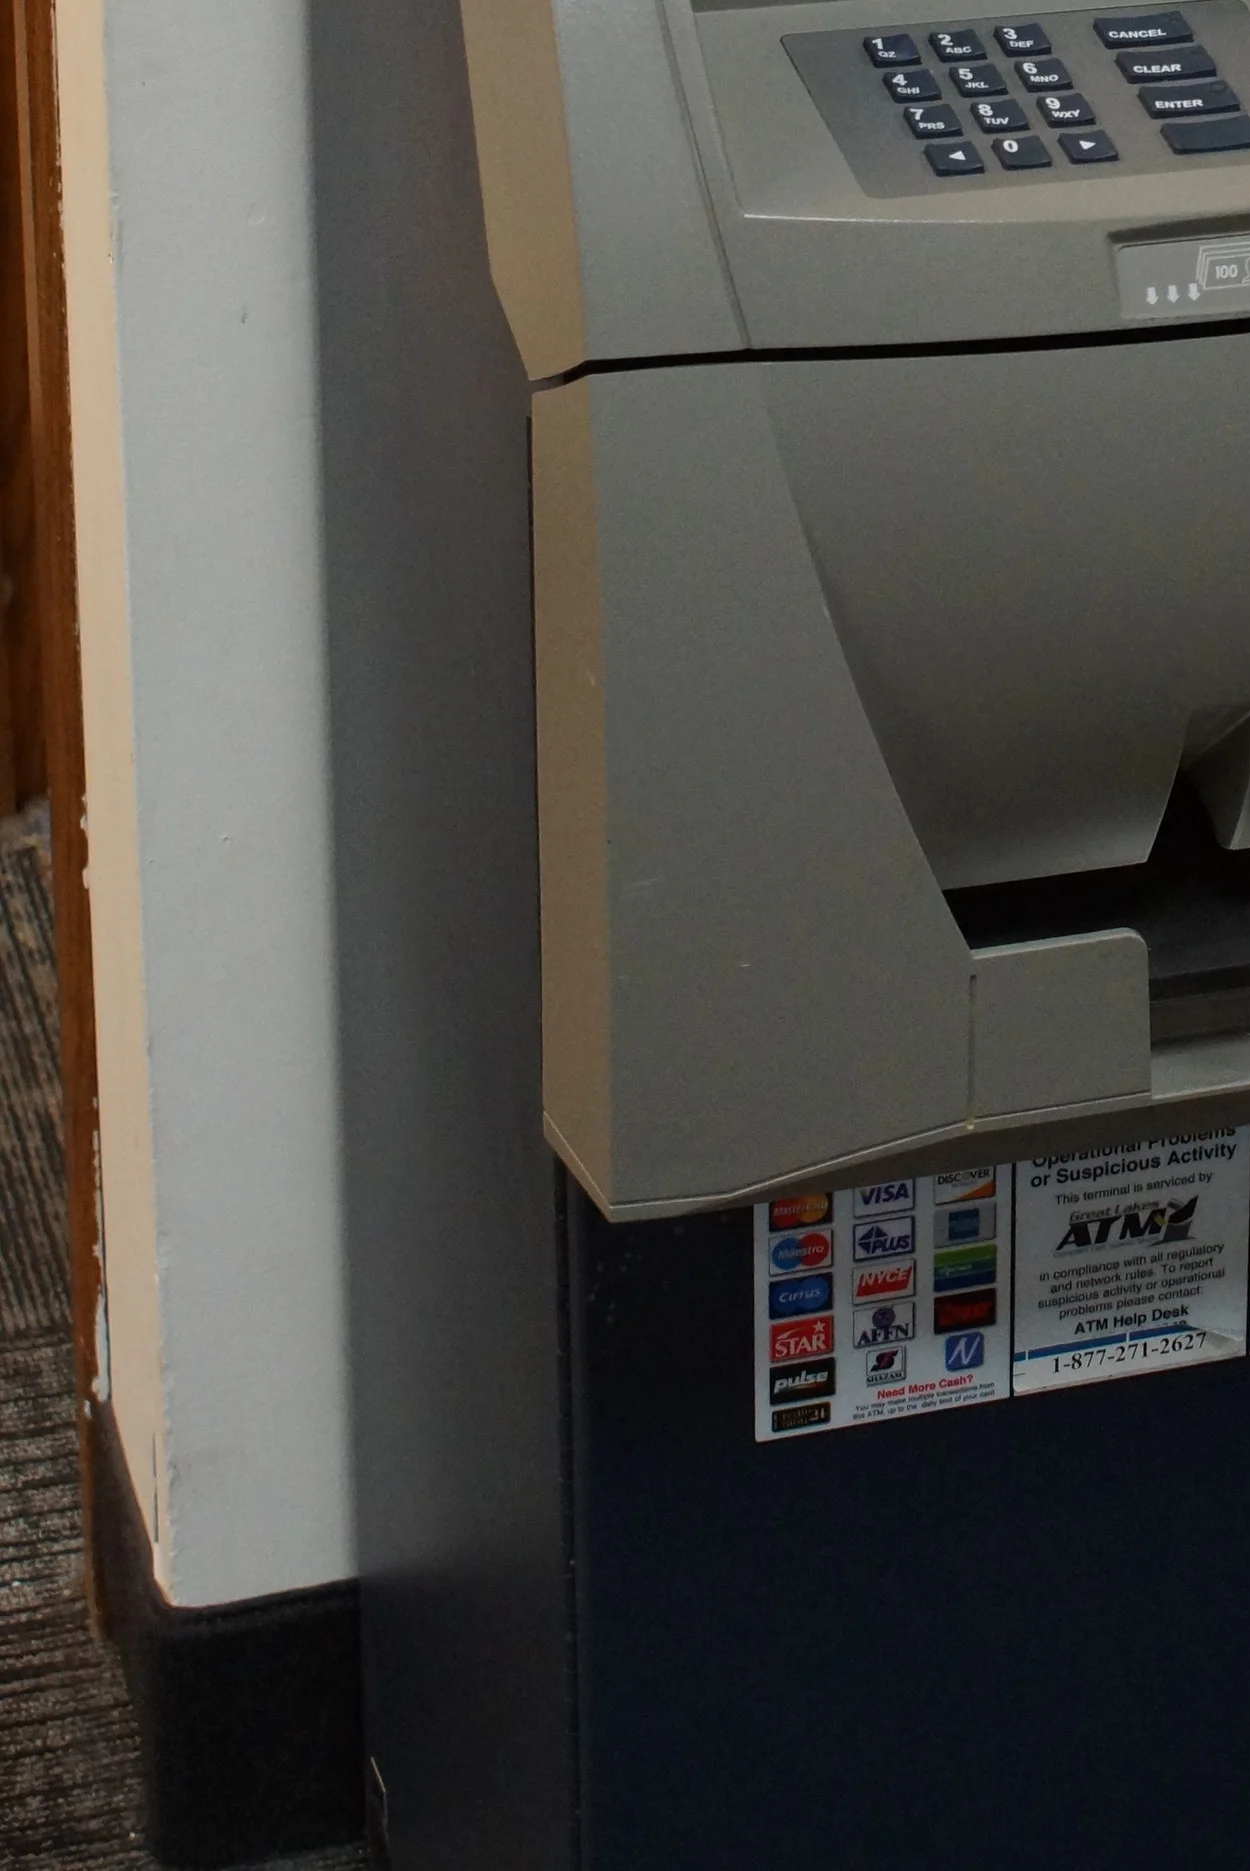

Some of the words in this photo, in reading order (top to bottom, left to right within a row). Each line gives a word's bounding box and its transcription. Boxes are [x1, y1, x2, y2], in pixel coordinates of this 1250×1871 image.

[938, 33, 954, 47] 2
[1002, 27, 1018, 41] 3
[1108, 27, 1167, 40] CANCEL
[871, 37, 883, 51] 1
[945, 45, 972, 56] ABC
[1009, 39, 1034, 50] DEF
[878, 50, 896, 59] QZ
[958, 68, 973, 82] 5
[1022, 62, 1038, 75] 6
[1132, 63, 1182, 75] CLEAR
[892, 73, 908, 88] 4
[965, 80, 989, 90] JKL
[1029, 73, 1060, 84] MNO
[896, 86, 920, 96] GHI
[977, 104, 993, 118] 8
[1045, 97, 1061, 111] 9
[1154, 98, 1204, 110] ENTER
[909, 108, 924, 122] 7
[983, 116, 1009, 126] TUV
[1051, 109, 1081, 120] WXY
[918, 121, 945, 132] PRS
[1003, 139, 1019, 154] 0
[1214, 264, 1239, 280] 100
[1030, 1173, 1051, 1188] or
[1056, 1155, 1161, 1184] Suspicious
[1167, 1142, 1238, 1166] Activity
[860, 1182, 910, 1206] VISA
[1055, 1192, 1080, 1206] This
[1083, 1185, 1131, 1201] terminal
[1133, 1182, 1144, 1193] is
[1146, 1173, 1196, 1191] serviced
[1199, 1171, 1214, 1185] by
[1056, 1207, 1166, 1251] ATM
[872, 1234, 911, 1255] PLUS
[1040, 1271, 1050, 1282] in
[1053, 1261, 1120, 1280] compliance
[1123, 1255, 1147, 1269] with
[1150, 1253, 1164, 1265] all
[1167, 1243, 1226, 1262] regulatory
[860, 1267, 909, 1287] NYCE
[1051, 1282, 1073, 1294] and
[1076, 1274, 1122, 1289] network
[1125, 1267, 1155, 1280] rules.
[1162, 1264, 1176, 1275] To
[1180, 1257, 1215, 1272] report
[779, 1288, 821, 1303] Cirrus
[1037, 1291, 1100, 1310] suspicious
[1103, 1282, 1143, 1298] activity
[1146, 1280, 1157, 1290] or
[1161, 1268, 1226, 1288] operational
[1058, 1302, 1114, 1321] problems
[1116, 1294, 1155, 1310] please
[1074, 1317, 1109, 1335] ATM
[1113, 1311, 1148, 1330] Help
[1151, 1304, 1190, 1323] Desk
[858, 1323, 910, 1345] AFFN
[774, 1332, 828, 1358] STAR
[1052, 1331, 1208, 1374] 1-877-271-2627
[774, 1370, 829, 1394] pulse
[877, 1387, 906, 1400] Need
[908, 1382, 936, 1395] More
[939, 1374, 974, 1388] Cash?
